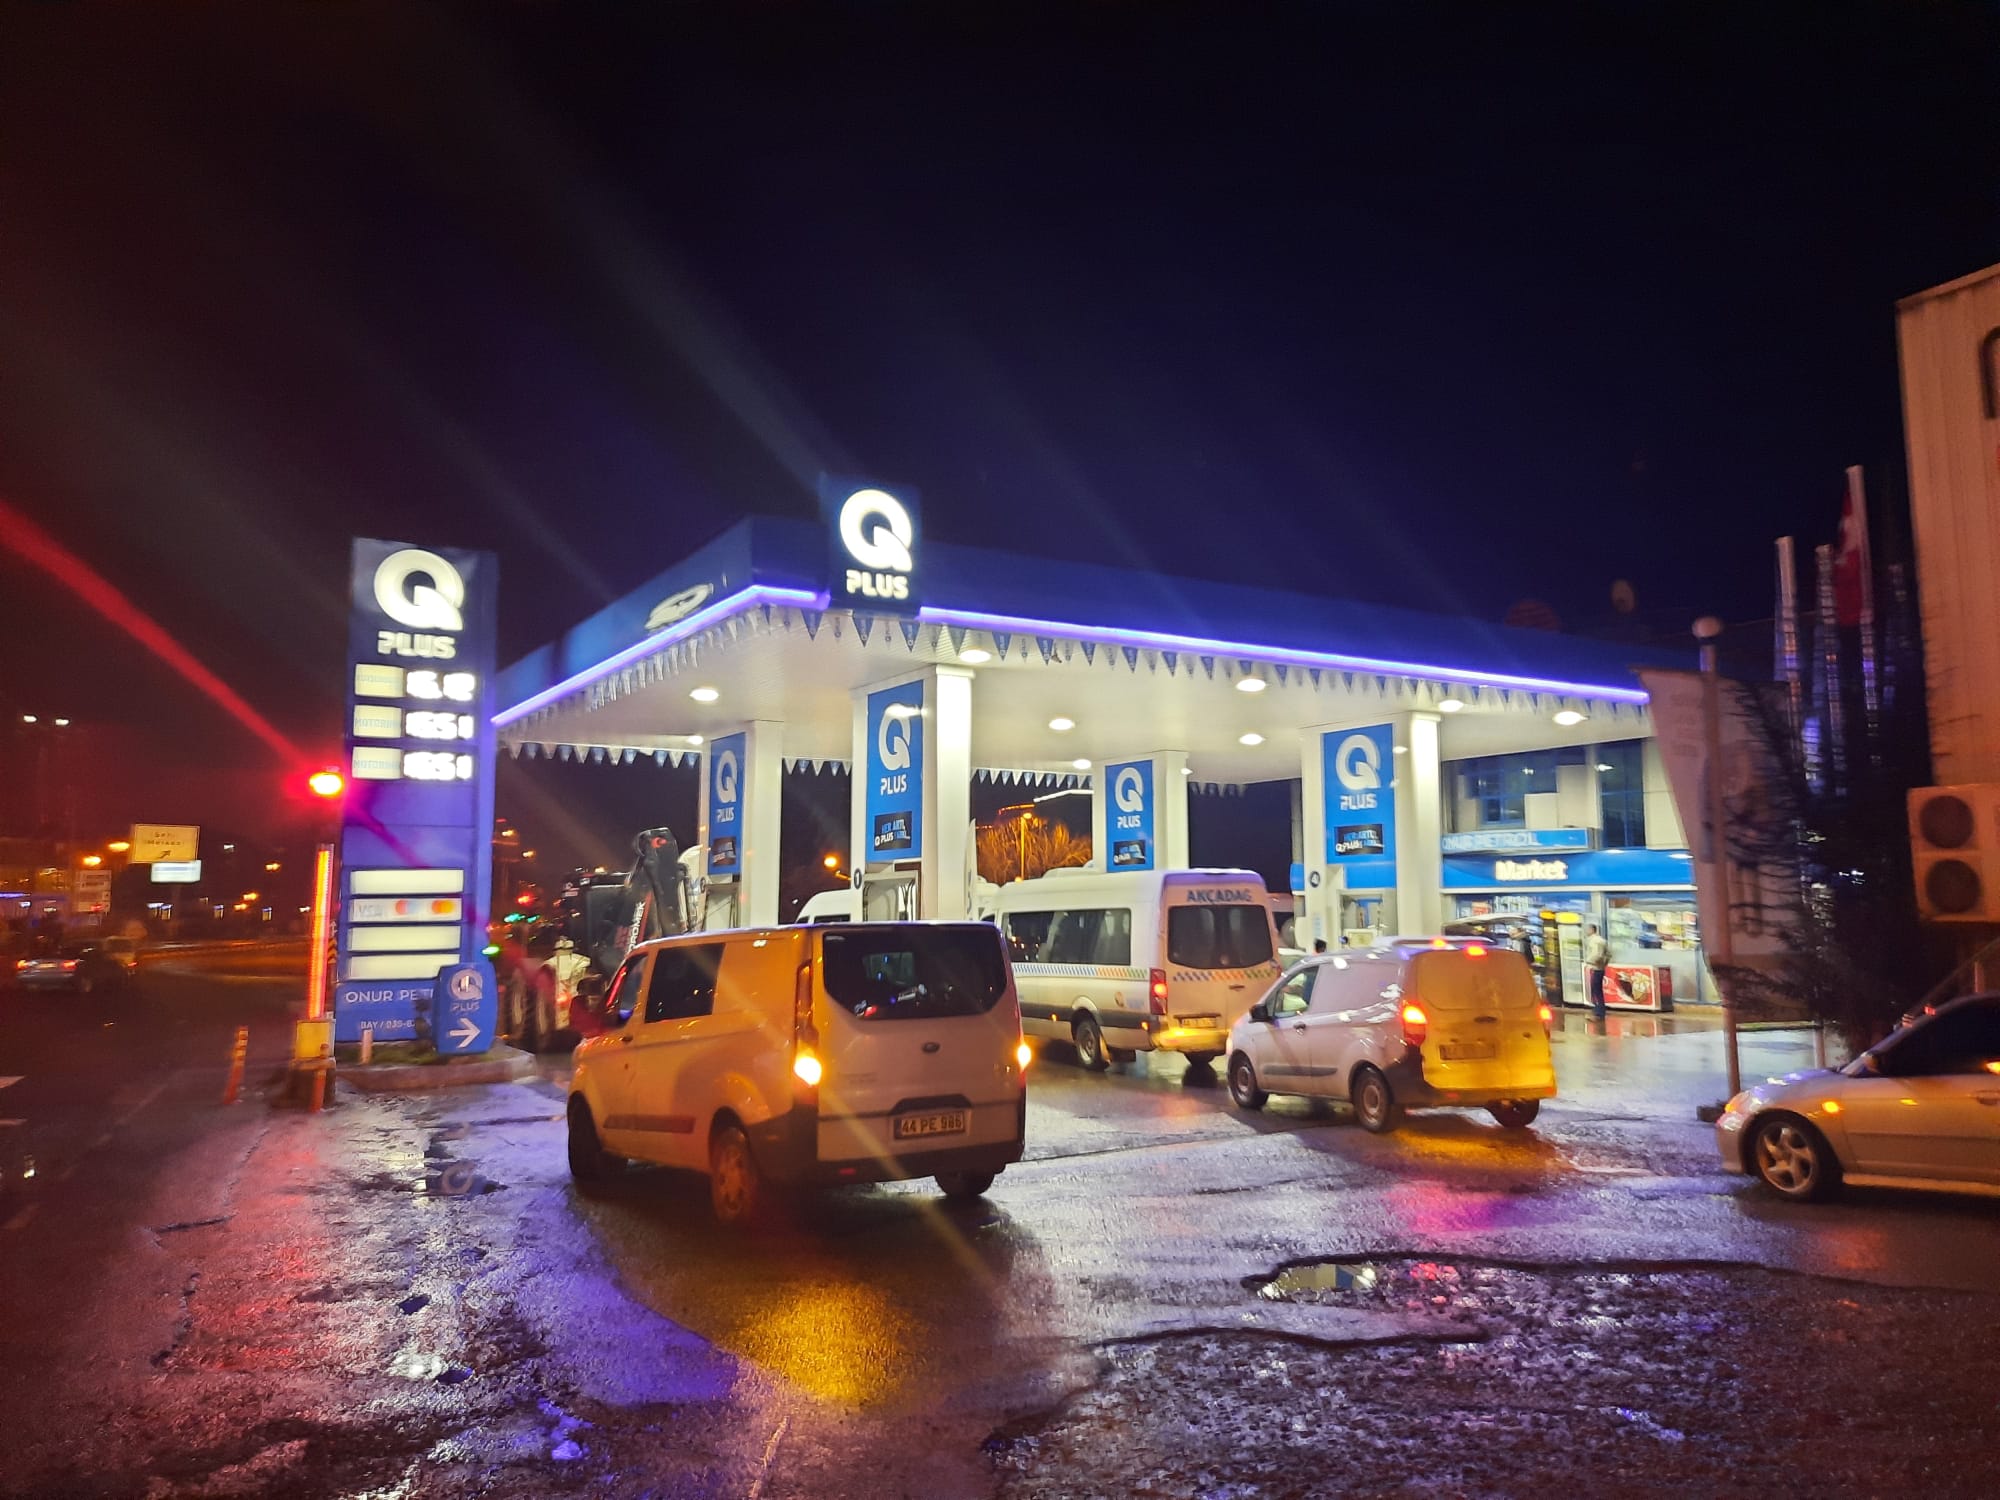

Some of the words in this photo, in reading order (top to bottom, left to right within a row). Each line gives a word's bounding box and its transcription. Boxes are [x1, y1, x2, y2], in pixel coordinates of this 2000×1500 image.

[839, 489, 913, 571] Q
[373, 549, 465, 631] Q
[846, 569, 910, 600] PLUS
[376, 630, 457, 659] PLUS
[879, 703, 912, 770] Q
[1335, 734, 1381, 790] Q
[715, 750, 738, 804] Q
[880, 774, 907, 796] PLUS
[1115, 767, 1144, 812] Q
[1339, 793, 1377, 811] PLUS
[716, 807, 735, 824] PLUS
[1117, 815, 1141, 829] PLUS
[881, 832, 894, 844] PLUS
[1496, 860, 1568, 880] Market
[345, 991, 393, 1003] ONUR
[452, 1001, 480, 1011] PLUS
[360, 1021, 378, 1029] BAY
[902, 1120, 916, 1132] 44
[920, 1117, 937, 1131] PE
